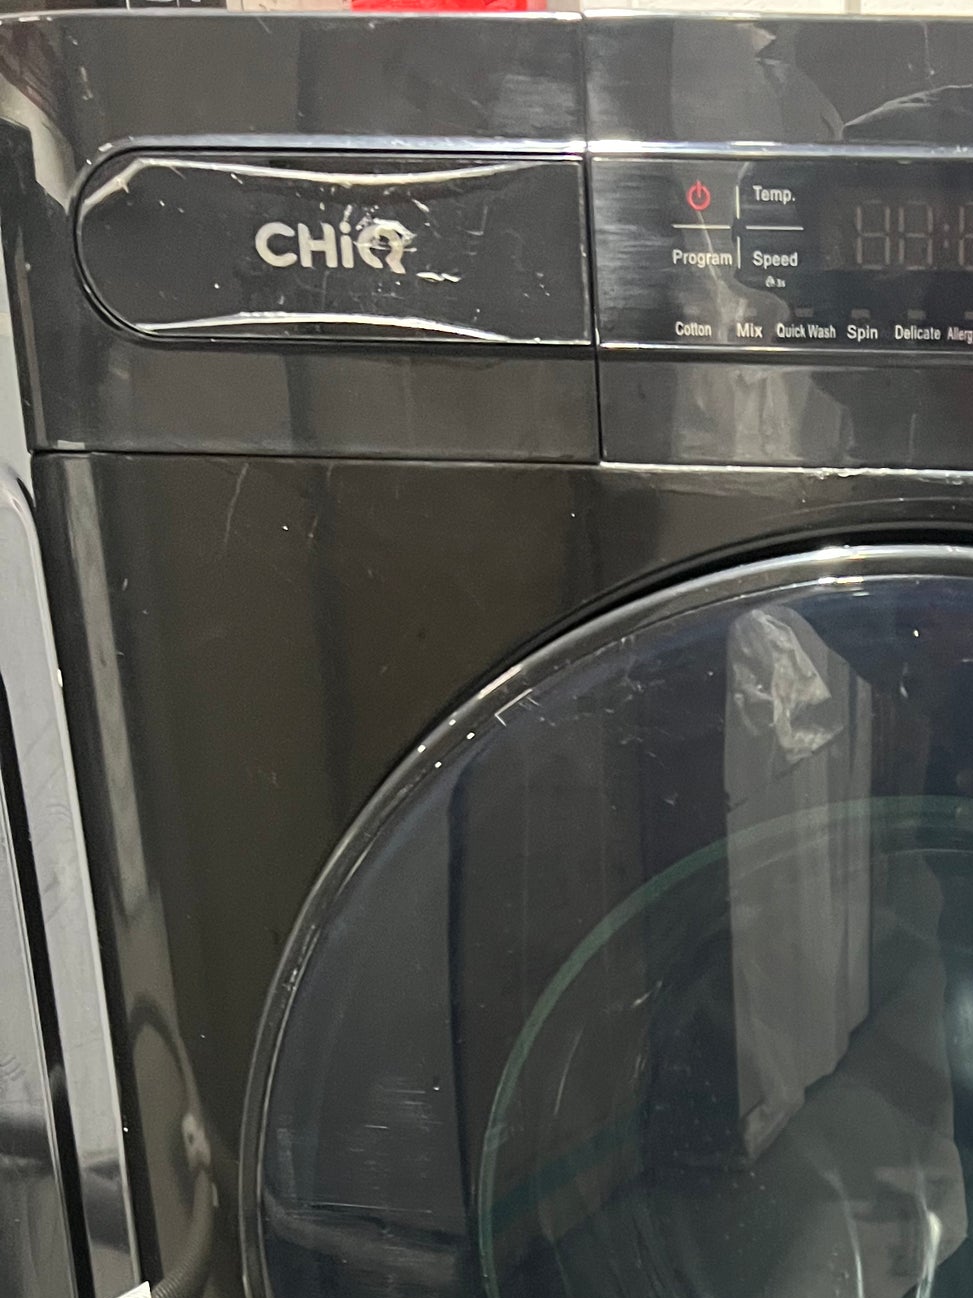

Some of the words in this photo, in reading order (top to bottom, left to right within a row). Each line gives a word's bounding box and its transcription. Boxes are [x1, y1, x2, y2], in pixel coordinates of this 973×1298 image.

[752, 185, 796, 205] Temp.
[672, 249, 732, 268] Program
[752, 251, 799, 269] Speed
[675, 321, 712, 336] Cotton
[736, 322, 763, 338] Mix
[776, 322, 805, 339] Quick
[808, 324, 836, 339] Wash
[846, 325, 878, 342] Spin
[894, 325, 941, 341] Delicate
